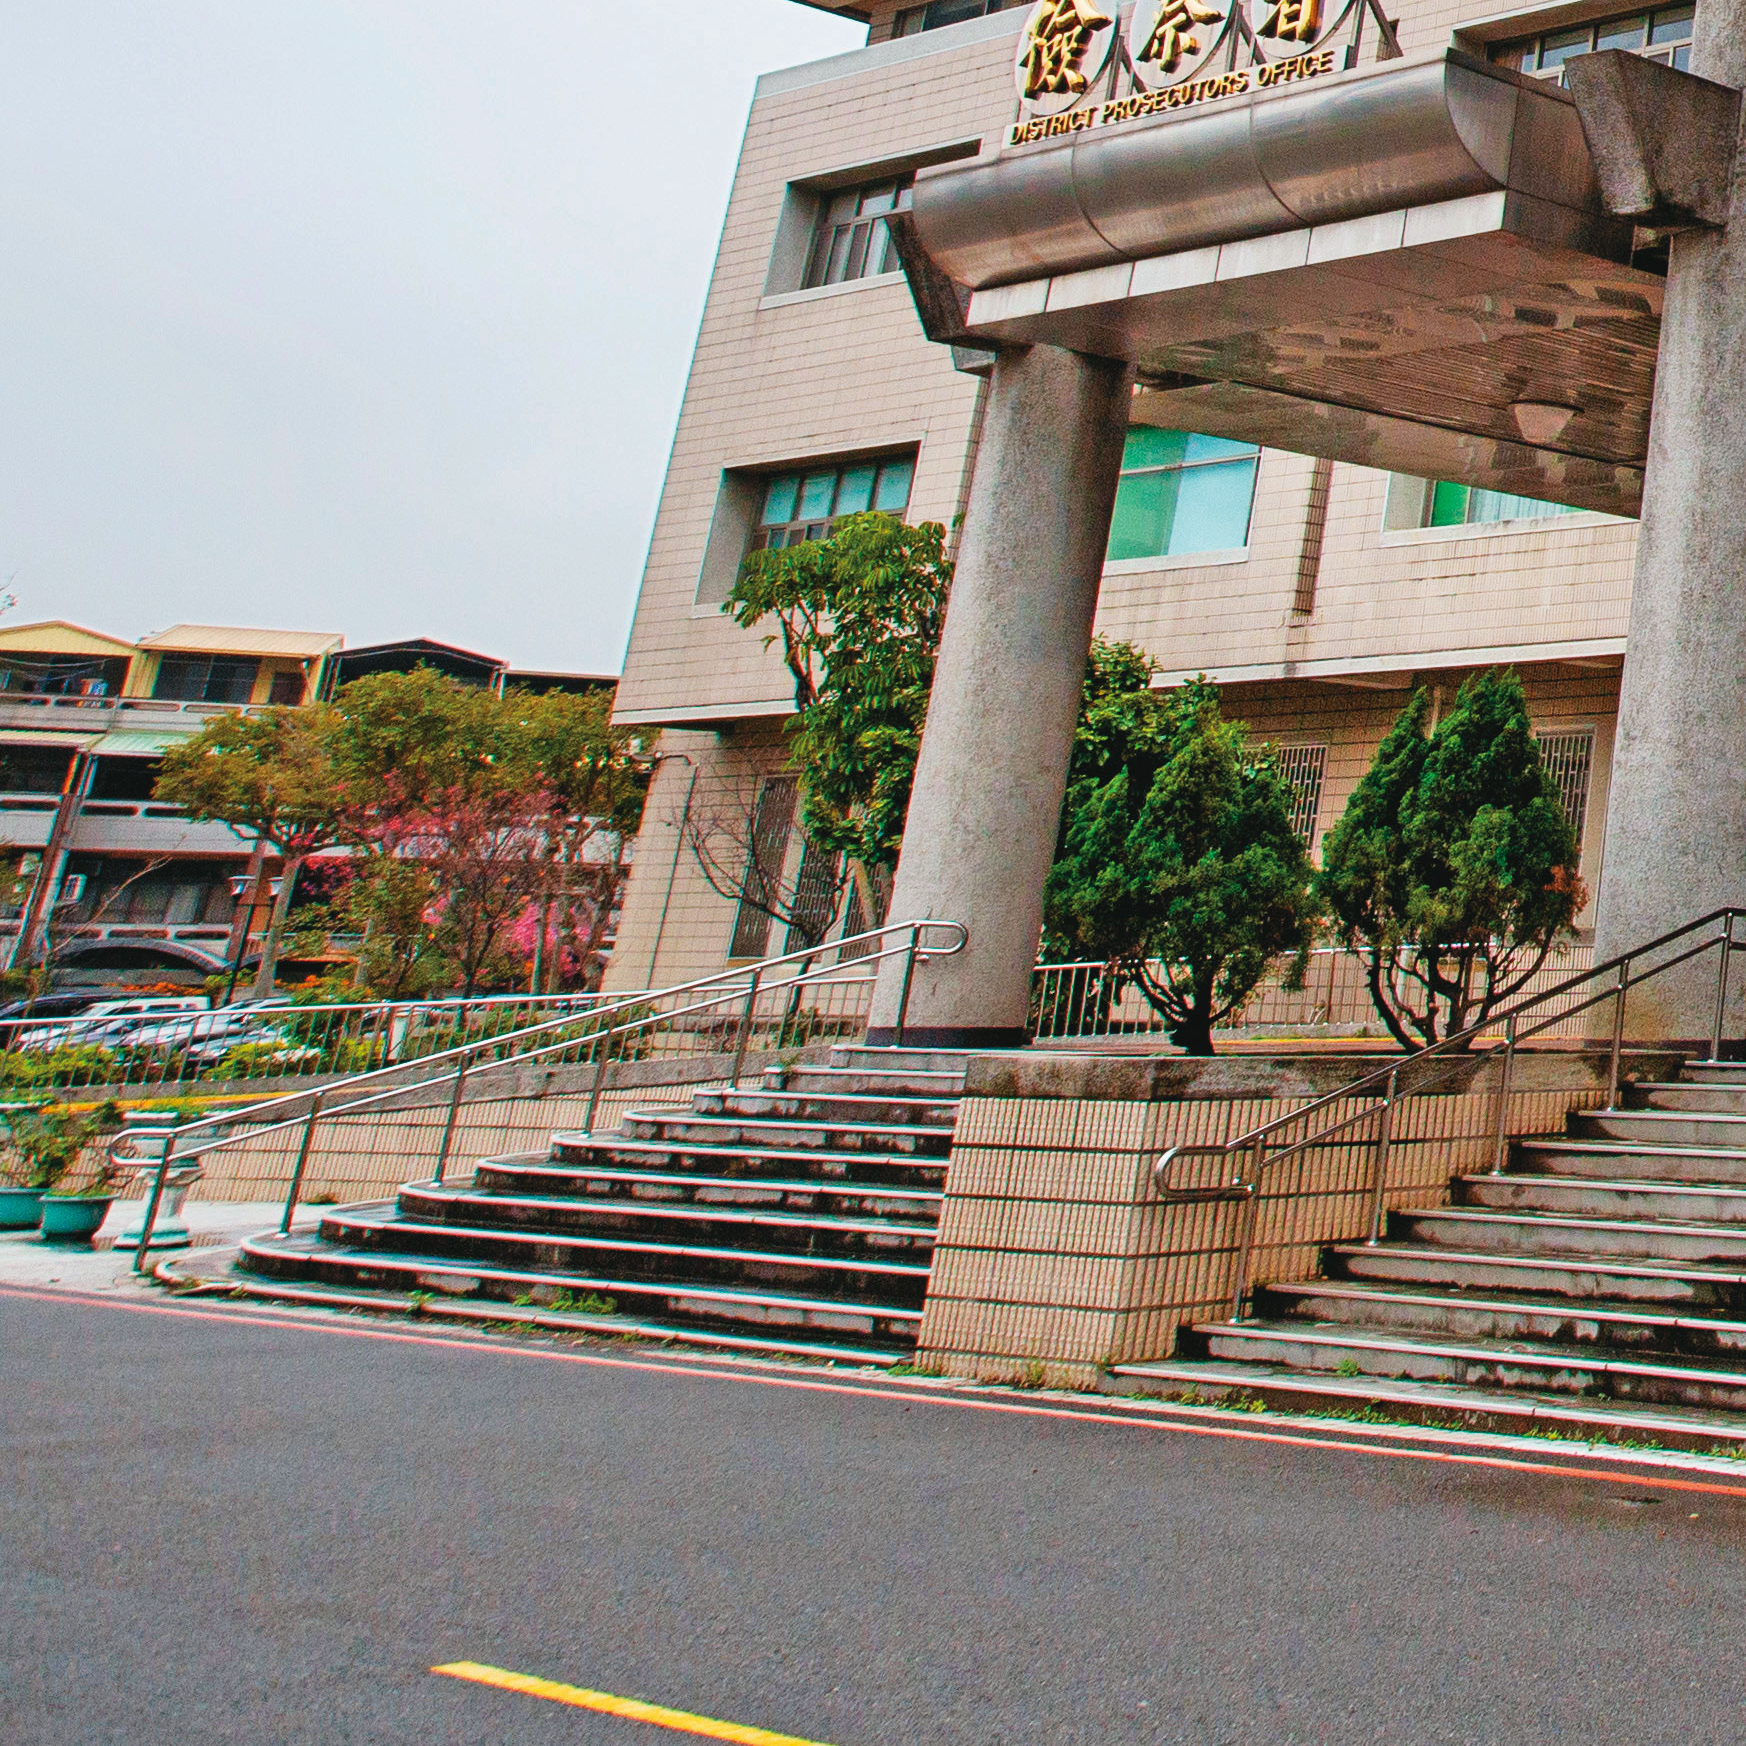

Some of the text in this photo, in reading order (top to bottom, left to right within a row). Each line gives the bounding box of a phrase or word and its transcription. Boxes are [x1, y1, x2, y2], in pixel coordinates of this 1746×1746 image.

[1009, 50, 1334, 145] DISTRICT PROSECUTORS OFFICE
